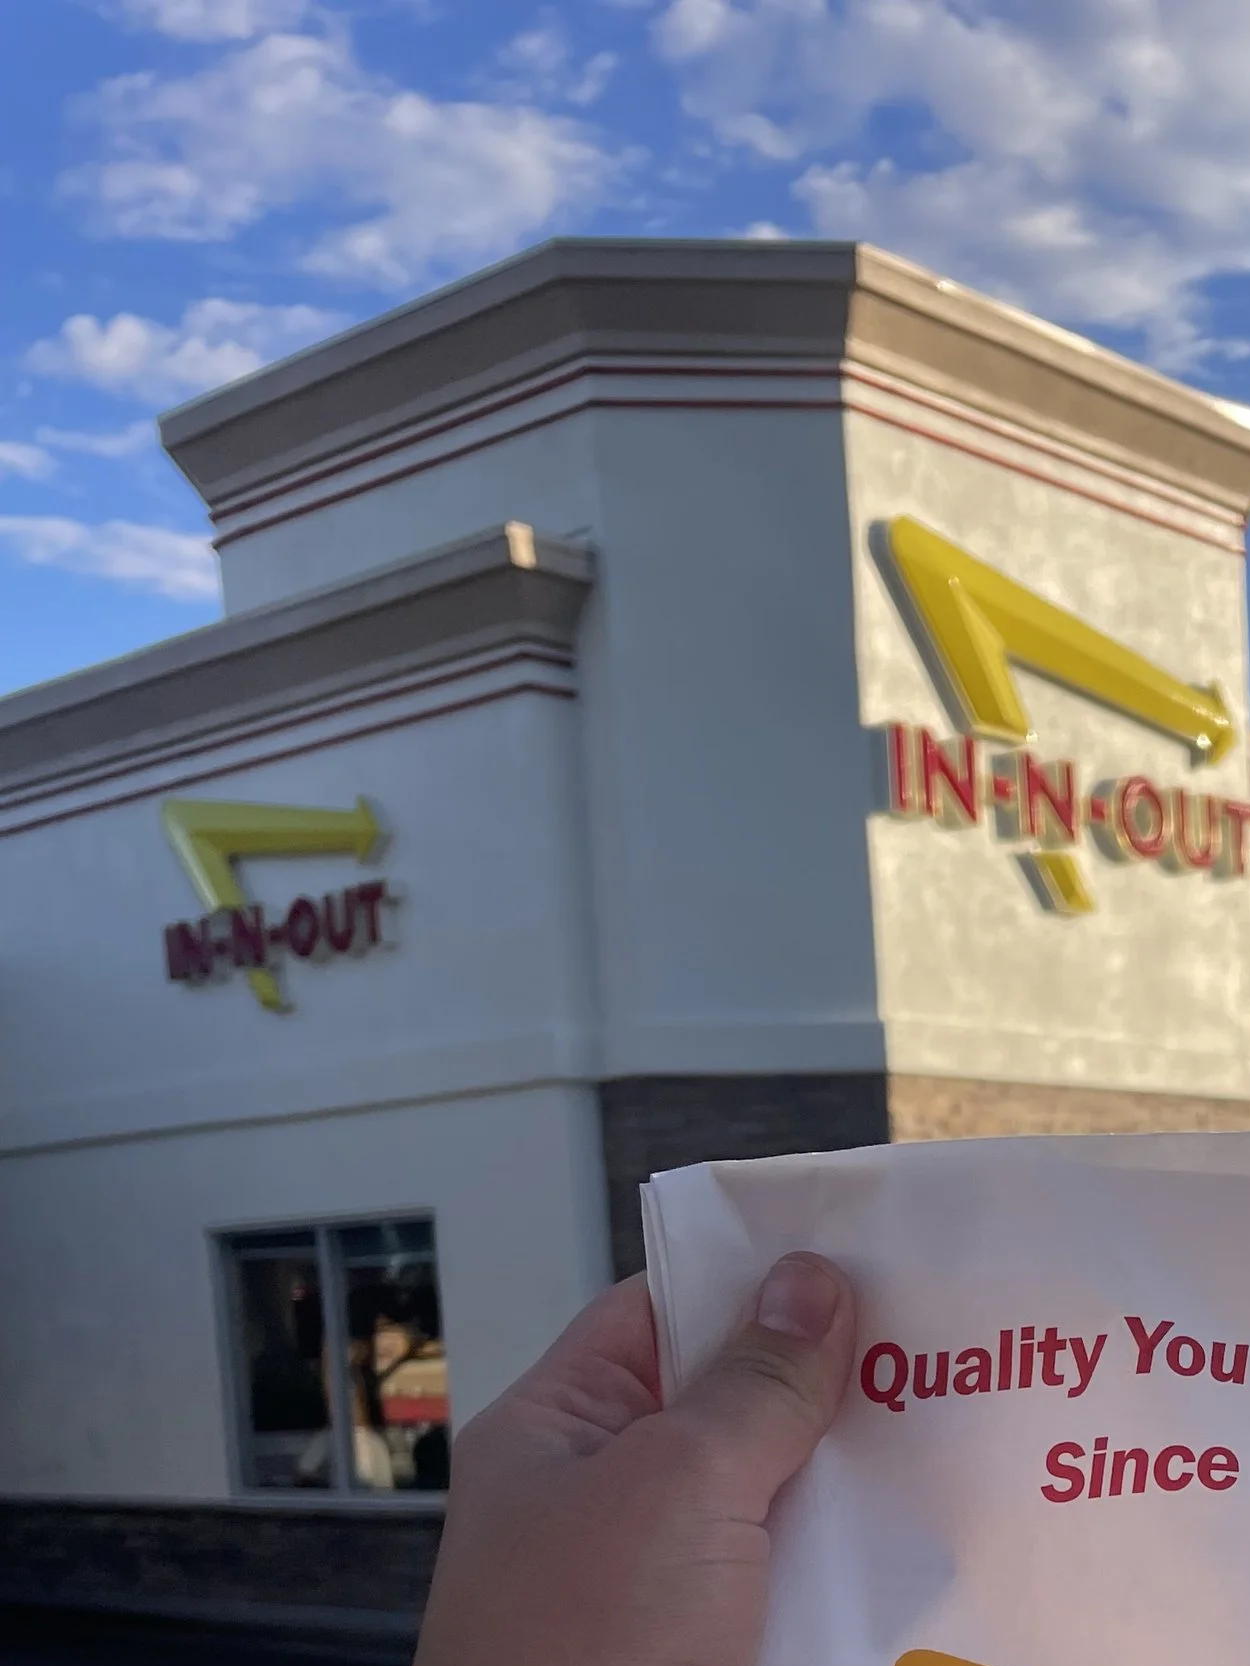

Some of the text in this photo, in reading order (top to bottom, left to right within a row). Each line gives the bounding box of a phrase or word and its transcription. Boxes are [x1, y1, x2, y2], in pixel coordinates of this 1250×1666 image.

[164, 880, 385, 980] IN-N-OUT
[861, 1327, 1107, 1412] Quality
[1125, 1317, 1248, 1384] You
[1040, 1436, 1239, 1504] Since
